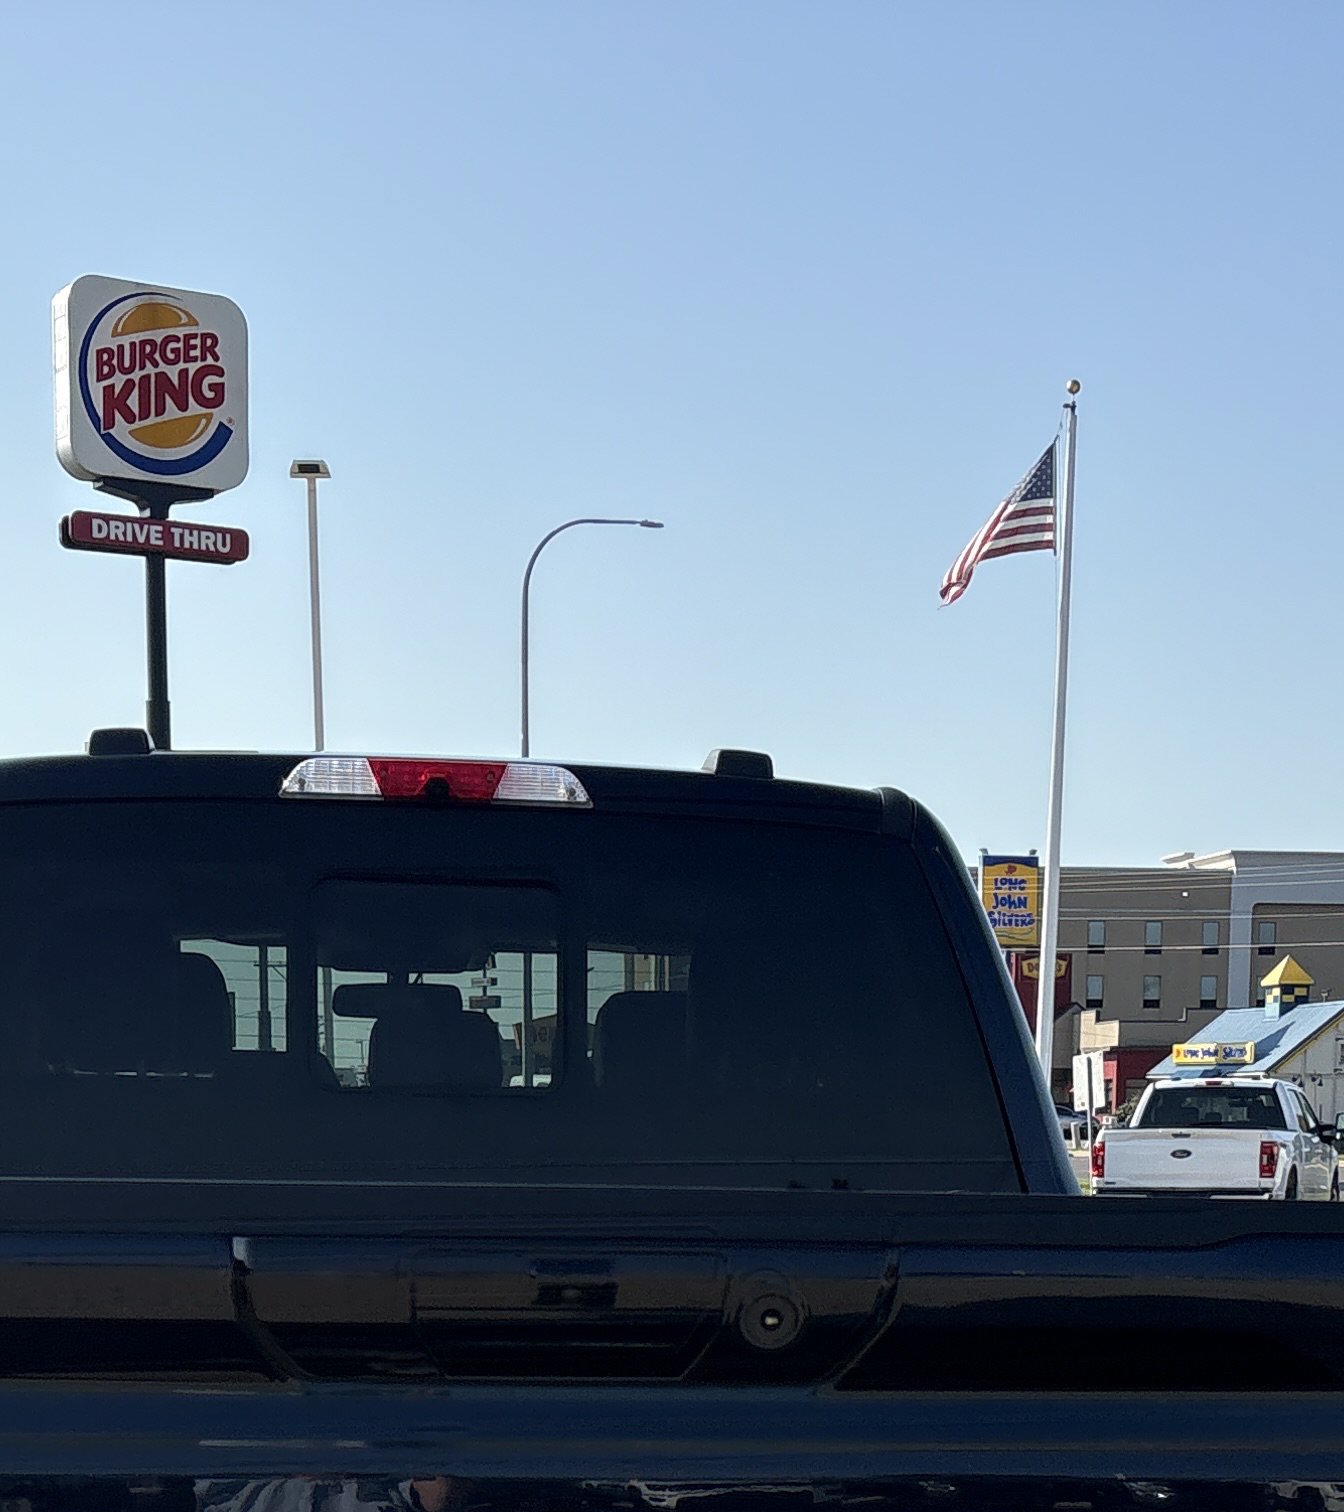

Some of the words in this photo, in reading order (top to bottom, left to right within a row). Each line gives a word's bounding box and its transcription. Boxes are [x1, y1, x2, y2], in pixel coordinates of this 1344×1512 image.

[96, 332, 220, 383] BURGER
[102, 364, 226, 432] KING
[91, 518, 164, 546] DRIVE
[170, 527, 232, 554] THRU
